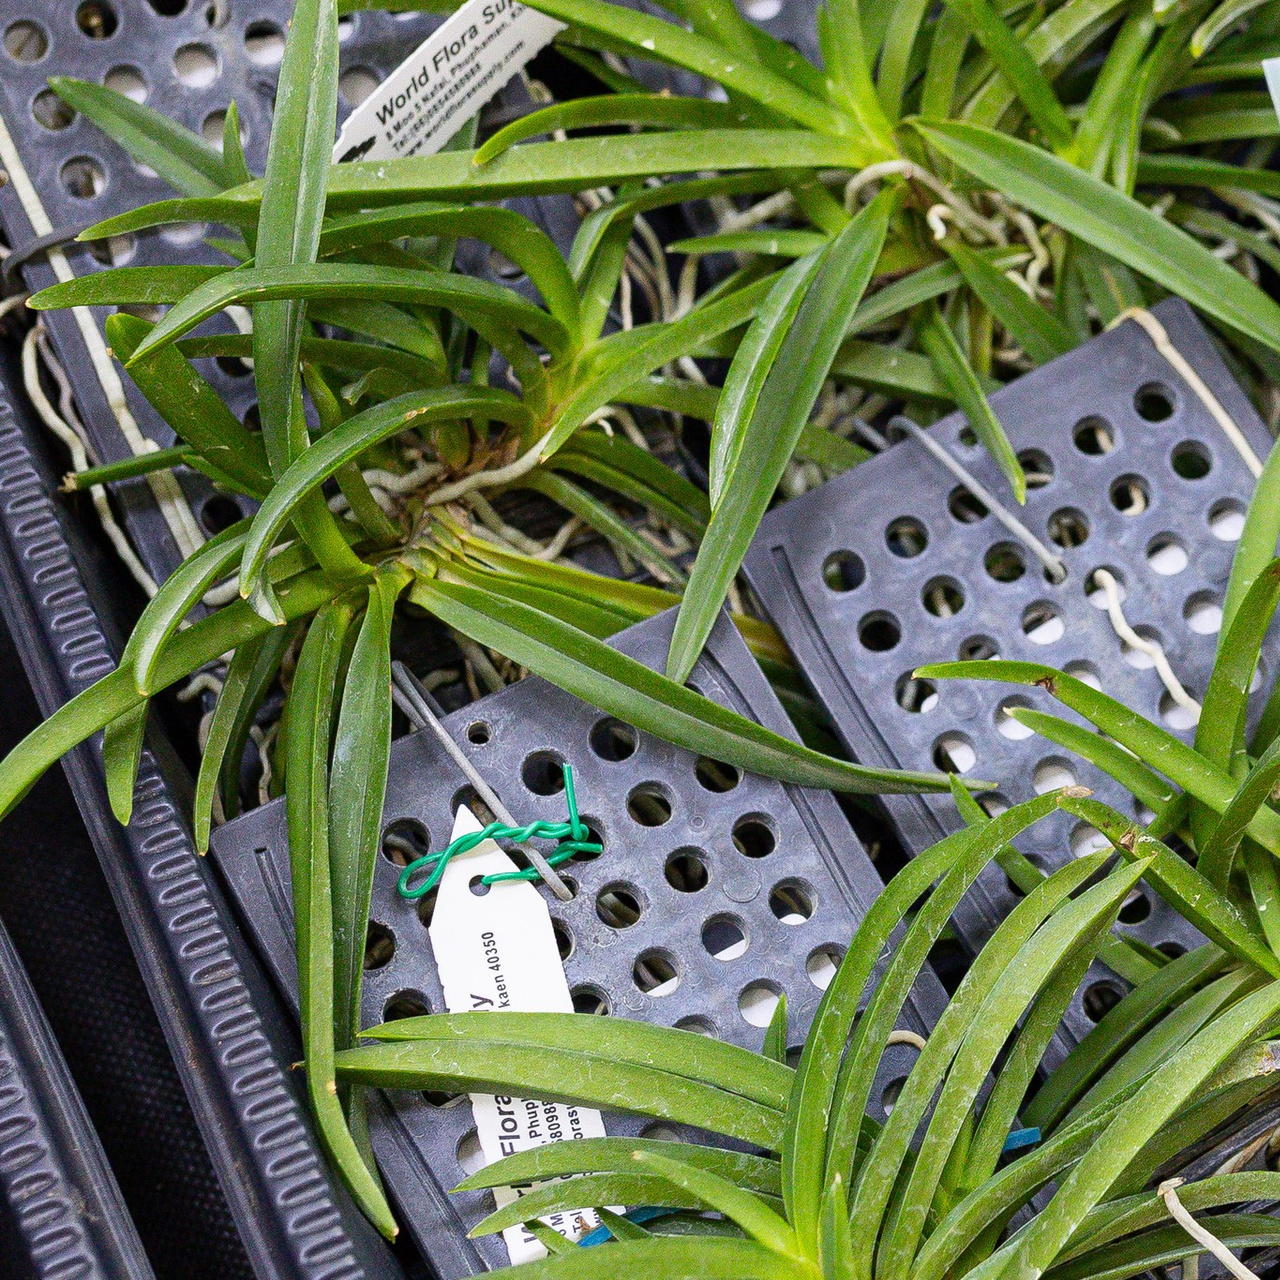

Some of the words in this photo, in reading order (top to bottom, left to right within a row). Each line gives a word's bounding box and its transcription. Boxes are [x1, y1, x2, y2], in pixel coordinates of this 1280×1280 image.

[375, 65, 429, 126] World
[432, 24, 480, 73] Flora
[481, 931, 501, 971] 40350
[494, 1095, 521, 1157] Flora
